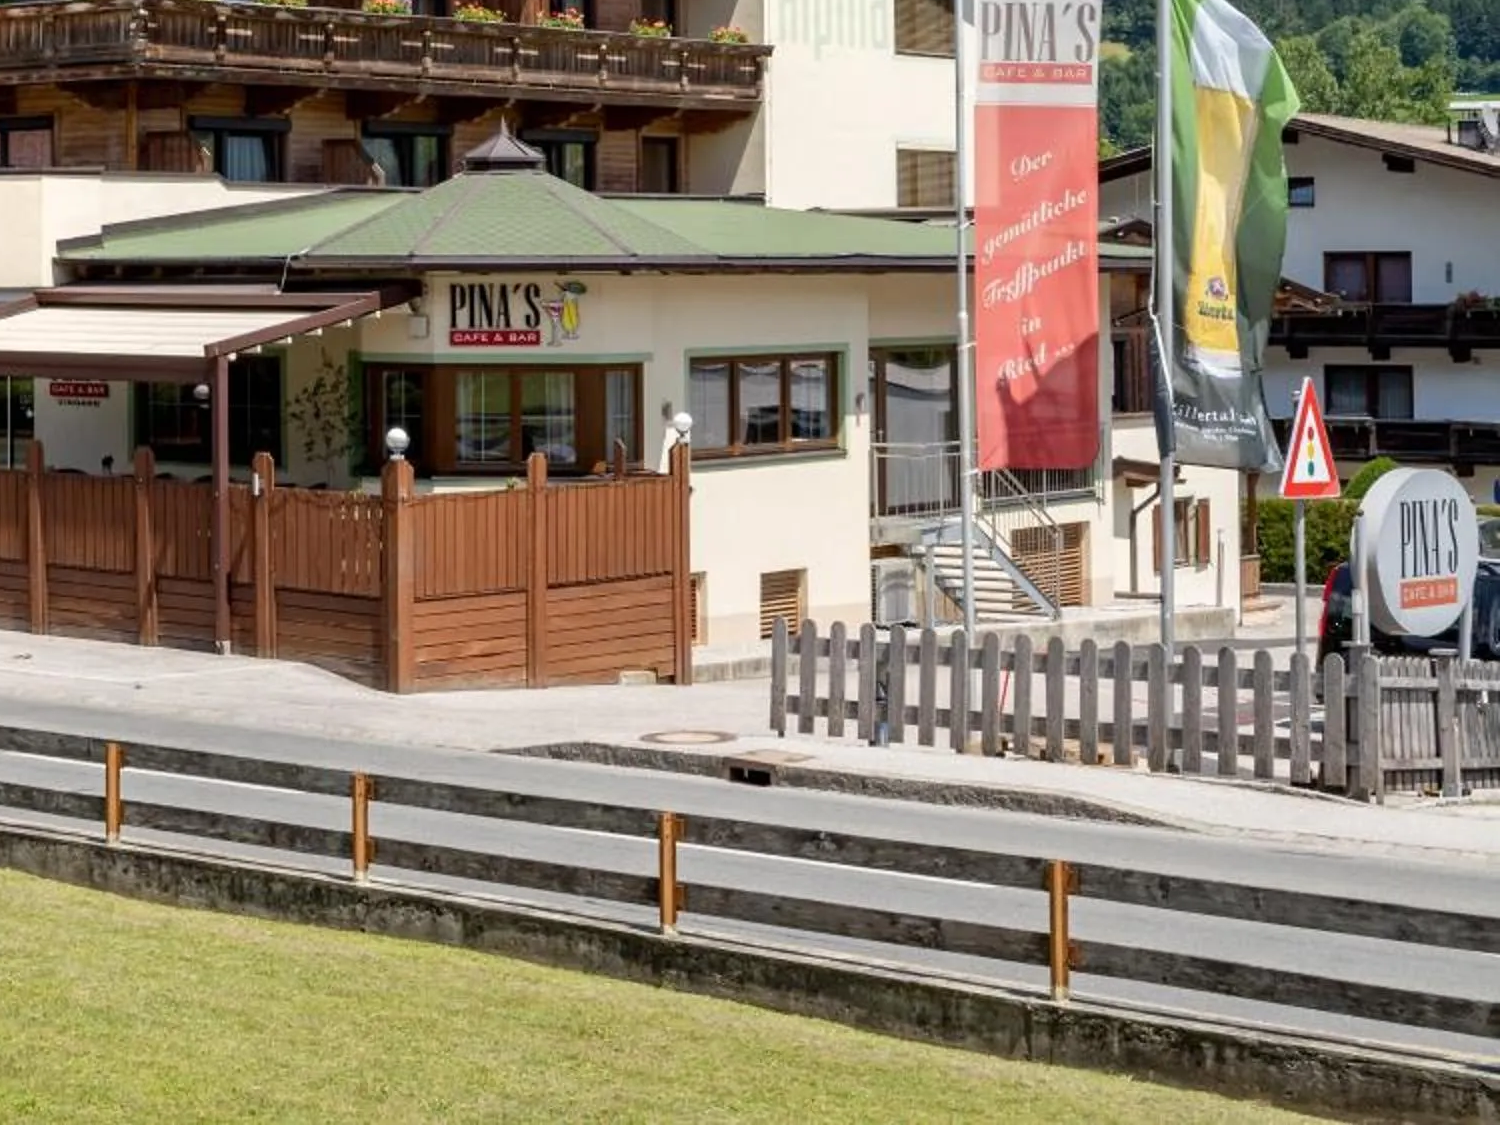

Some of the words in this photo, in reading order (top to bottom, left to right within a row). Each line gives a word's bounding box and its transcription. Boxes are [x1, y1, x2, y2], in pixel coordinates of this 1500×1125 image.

[1011, 151, 1053, 182] Der
[981, 188, 1088, 266] gemütliche
[982, 239, 1085, 308] Treffpunkt
[509, 333, 537, 343] BAR
[1021, 316, 1042, 336] in
[998, 341, 1046, 382] Ried
